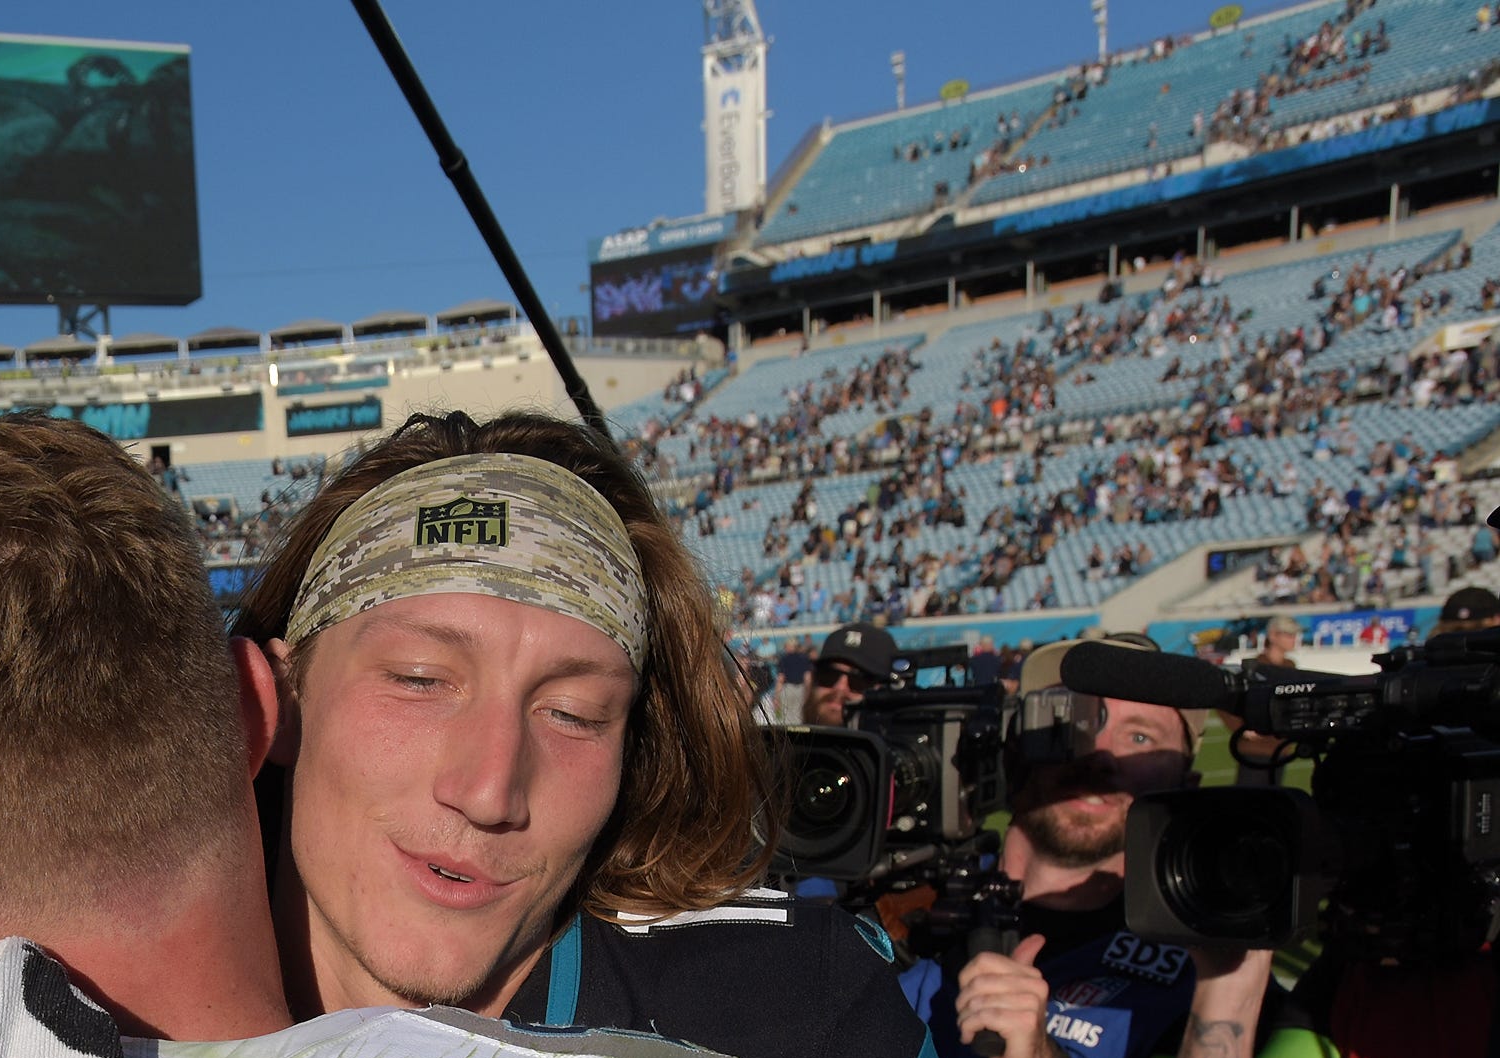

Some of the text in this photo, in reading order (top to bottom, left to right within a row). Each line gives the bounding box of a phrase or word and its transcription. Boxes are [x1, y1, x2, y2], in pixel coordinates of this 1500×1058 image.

[424, 519, 499, 546] NFL
[1274, 682, 1316, 696] SONY
[1107, 934, 1185, 975] SDS
[1046, 1012, 1104, 1048] FILMS
